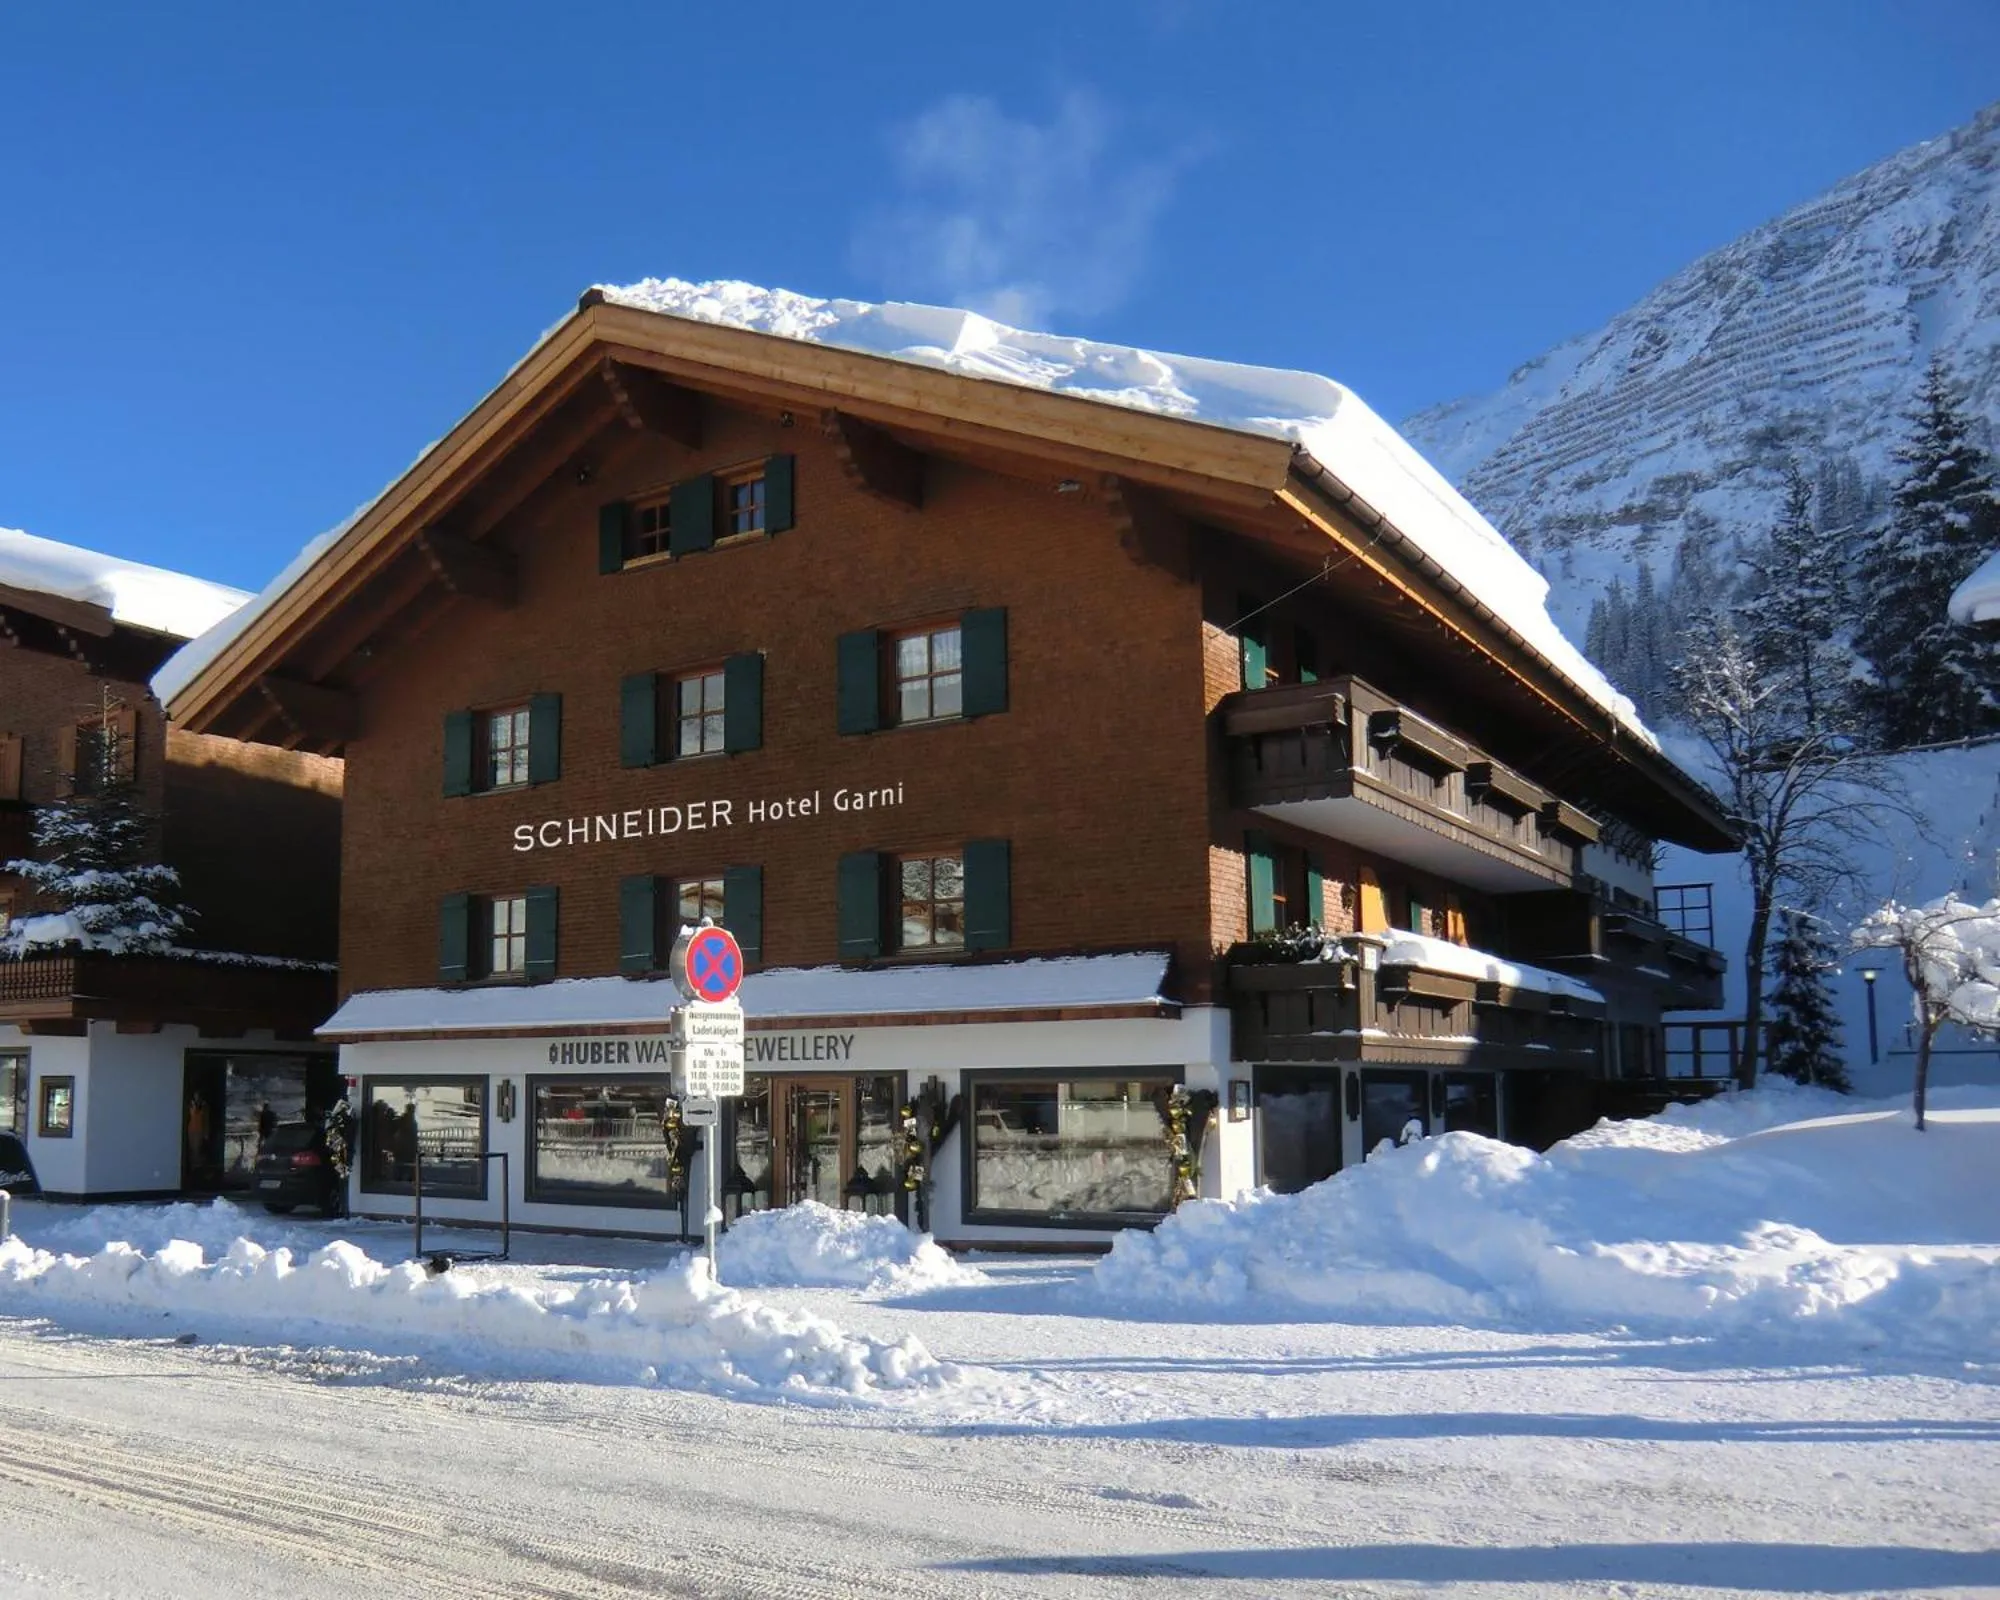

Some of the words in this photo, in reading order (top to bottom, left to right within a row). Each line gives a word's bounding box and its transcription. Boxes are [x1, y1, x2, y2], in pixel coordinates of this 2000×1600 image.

[512, 799, 734, 853] SCHNEIDER
[748, 790, 821, 823] Hotel
[832, 782, 905, 812] Garni
[560, 1040, 630, 1065] HUBER
